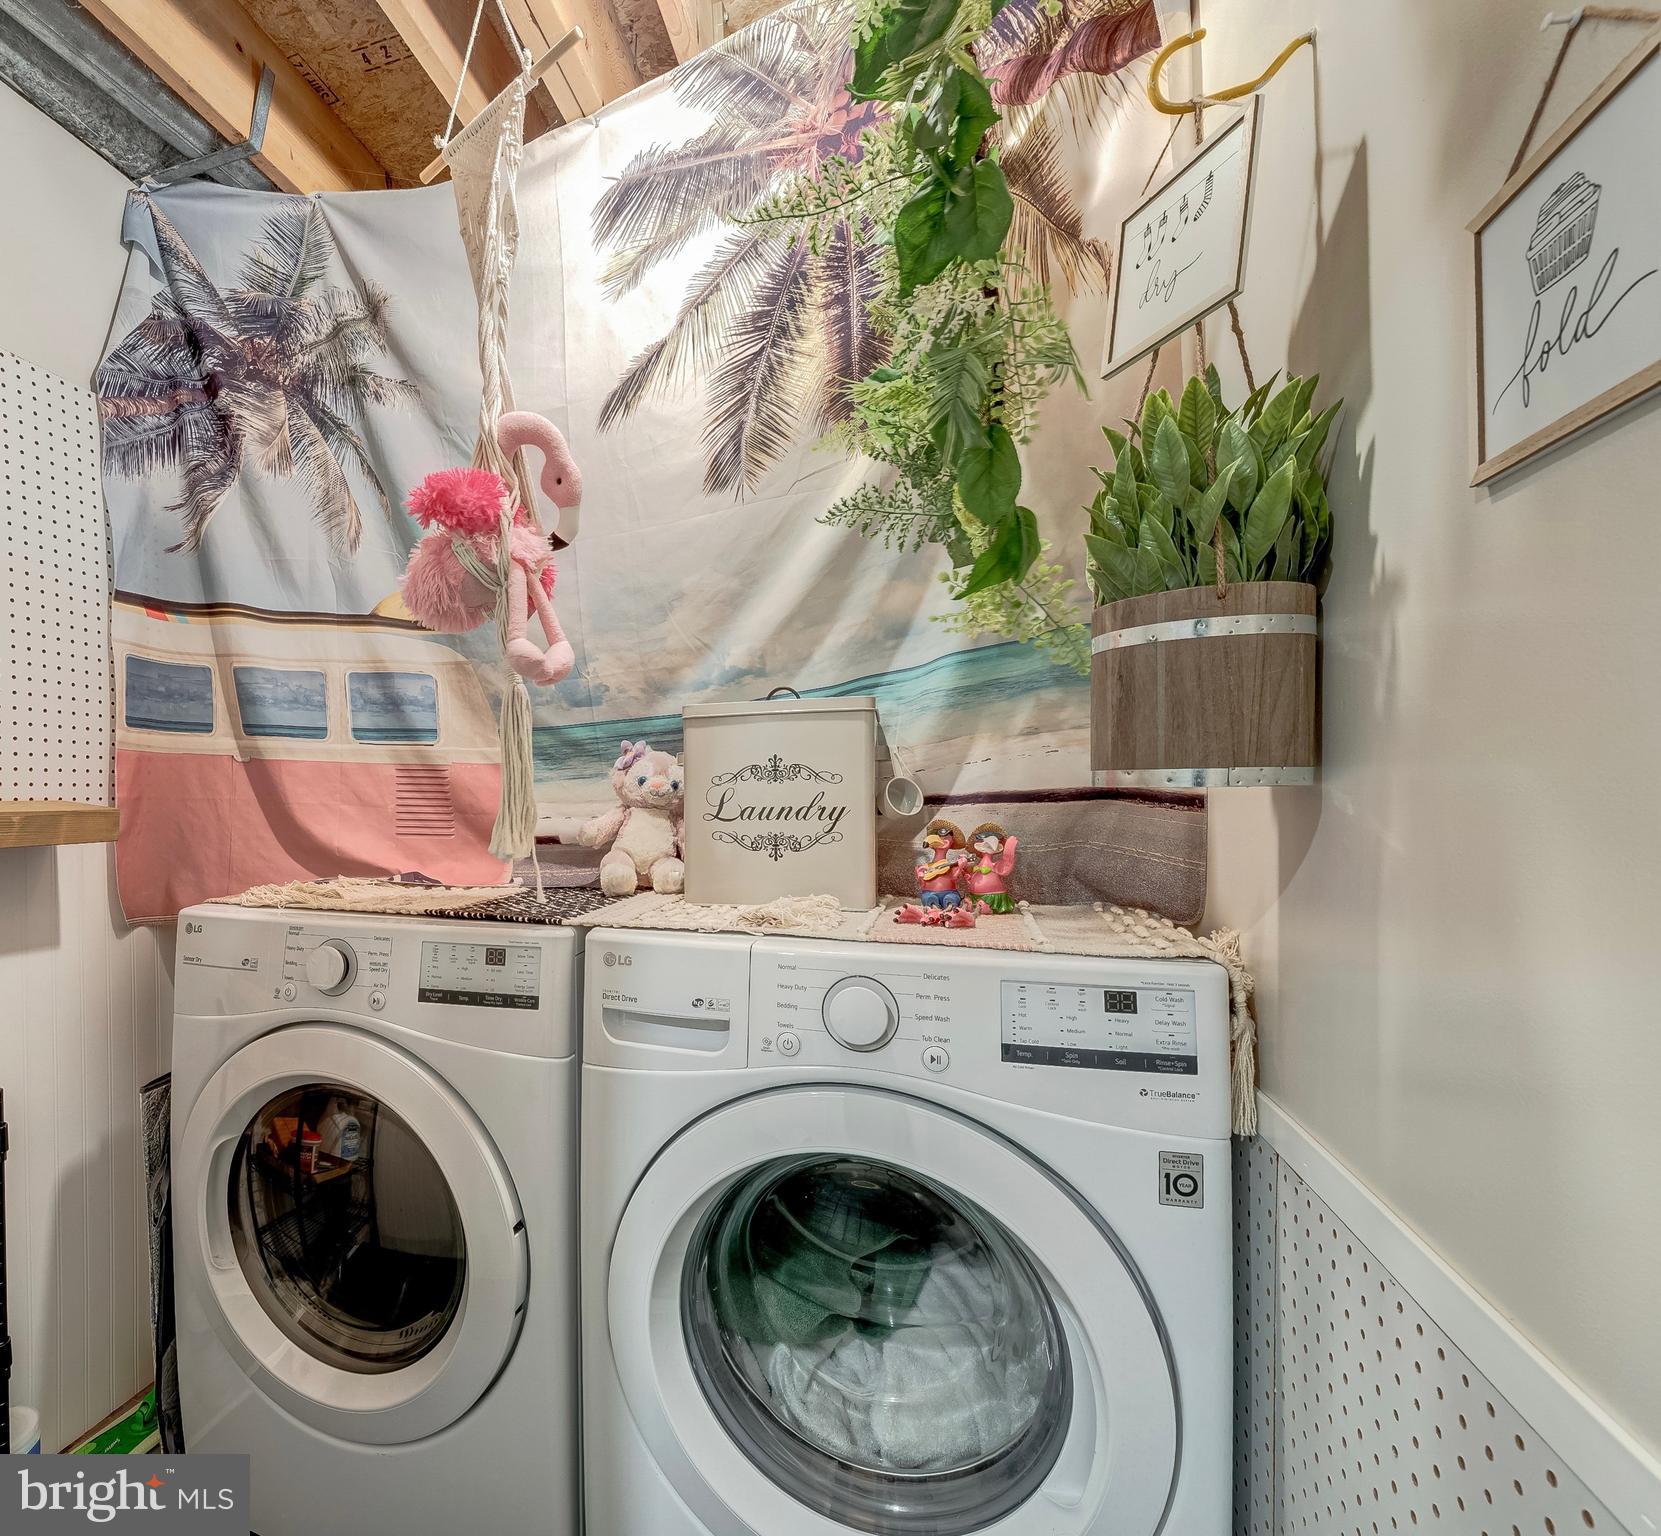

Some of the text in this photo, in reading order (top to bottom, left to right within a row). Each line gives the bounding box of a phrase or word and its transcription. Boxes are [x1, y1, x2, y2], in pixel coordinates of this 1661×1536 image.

[1138, 250, 1204, 310] dry
[1493, 246, 1659, 416] fold
[702, 787, 852, 834] Laundry
[923, 972, 950, 980] Delicates
[794, 983, 807, 991] Duty
[602, 992, 638, 1004] Direct Drive
[776, 1002, 798, 1010] Bedding
[914, 1013, 950, 1022] Speed Wash
[933, 1035, 950, 1043] Clean
[1064, 1050, 1078, 1059] Spin
[1162, 1157, 1200, 1167] Direct Drive
[1163, 1172, 1199, 1198] 10
